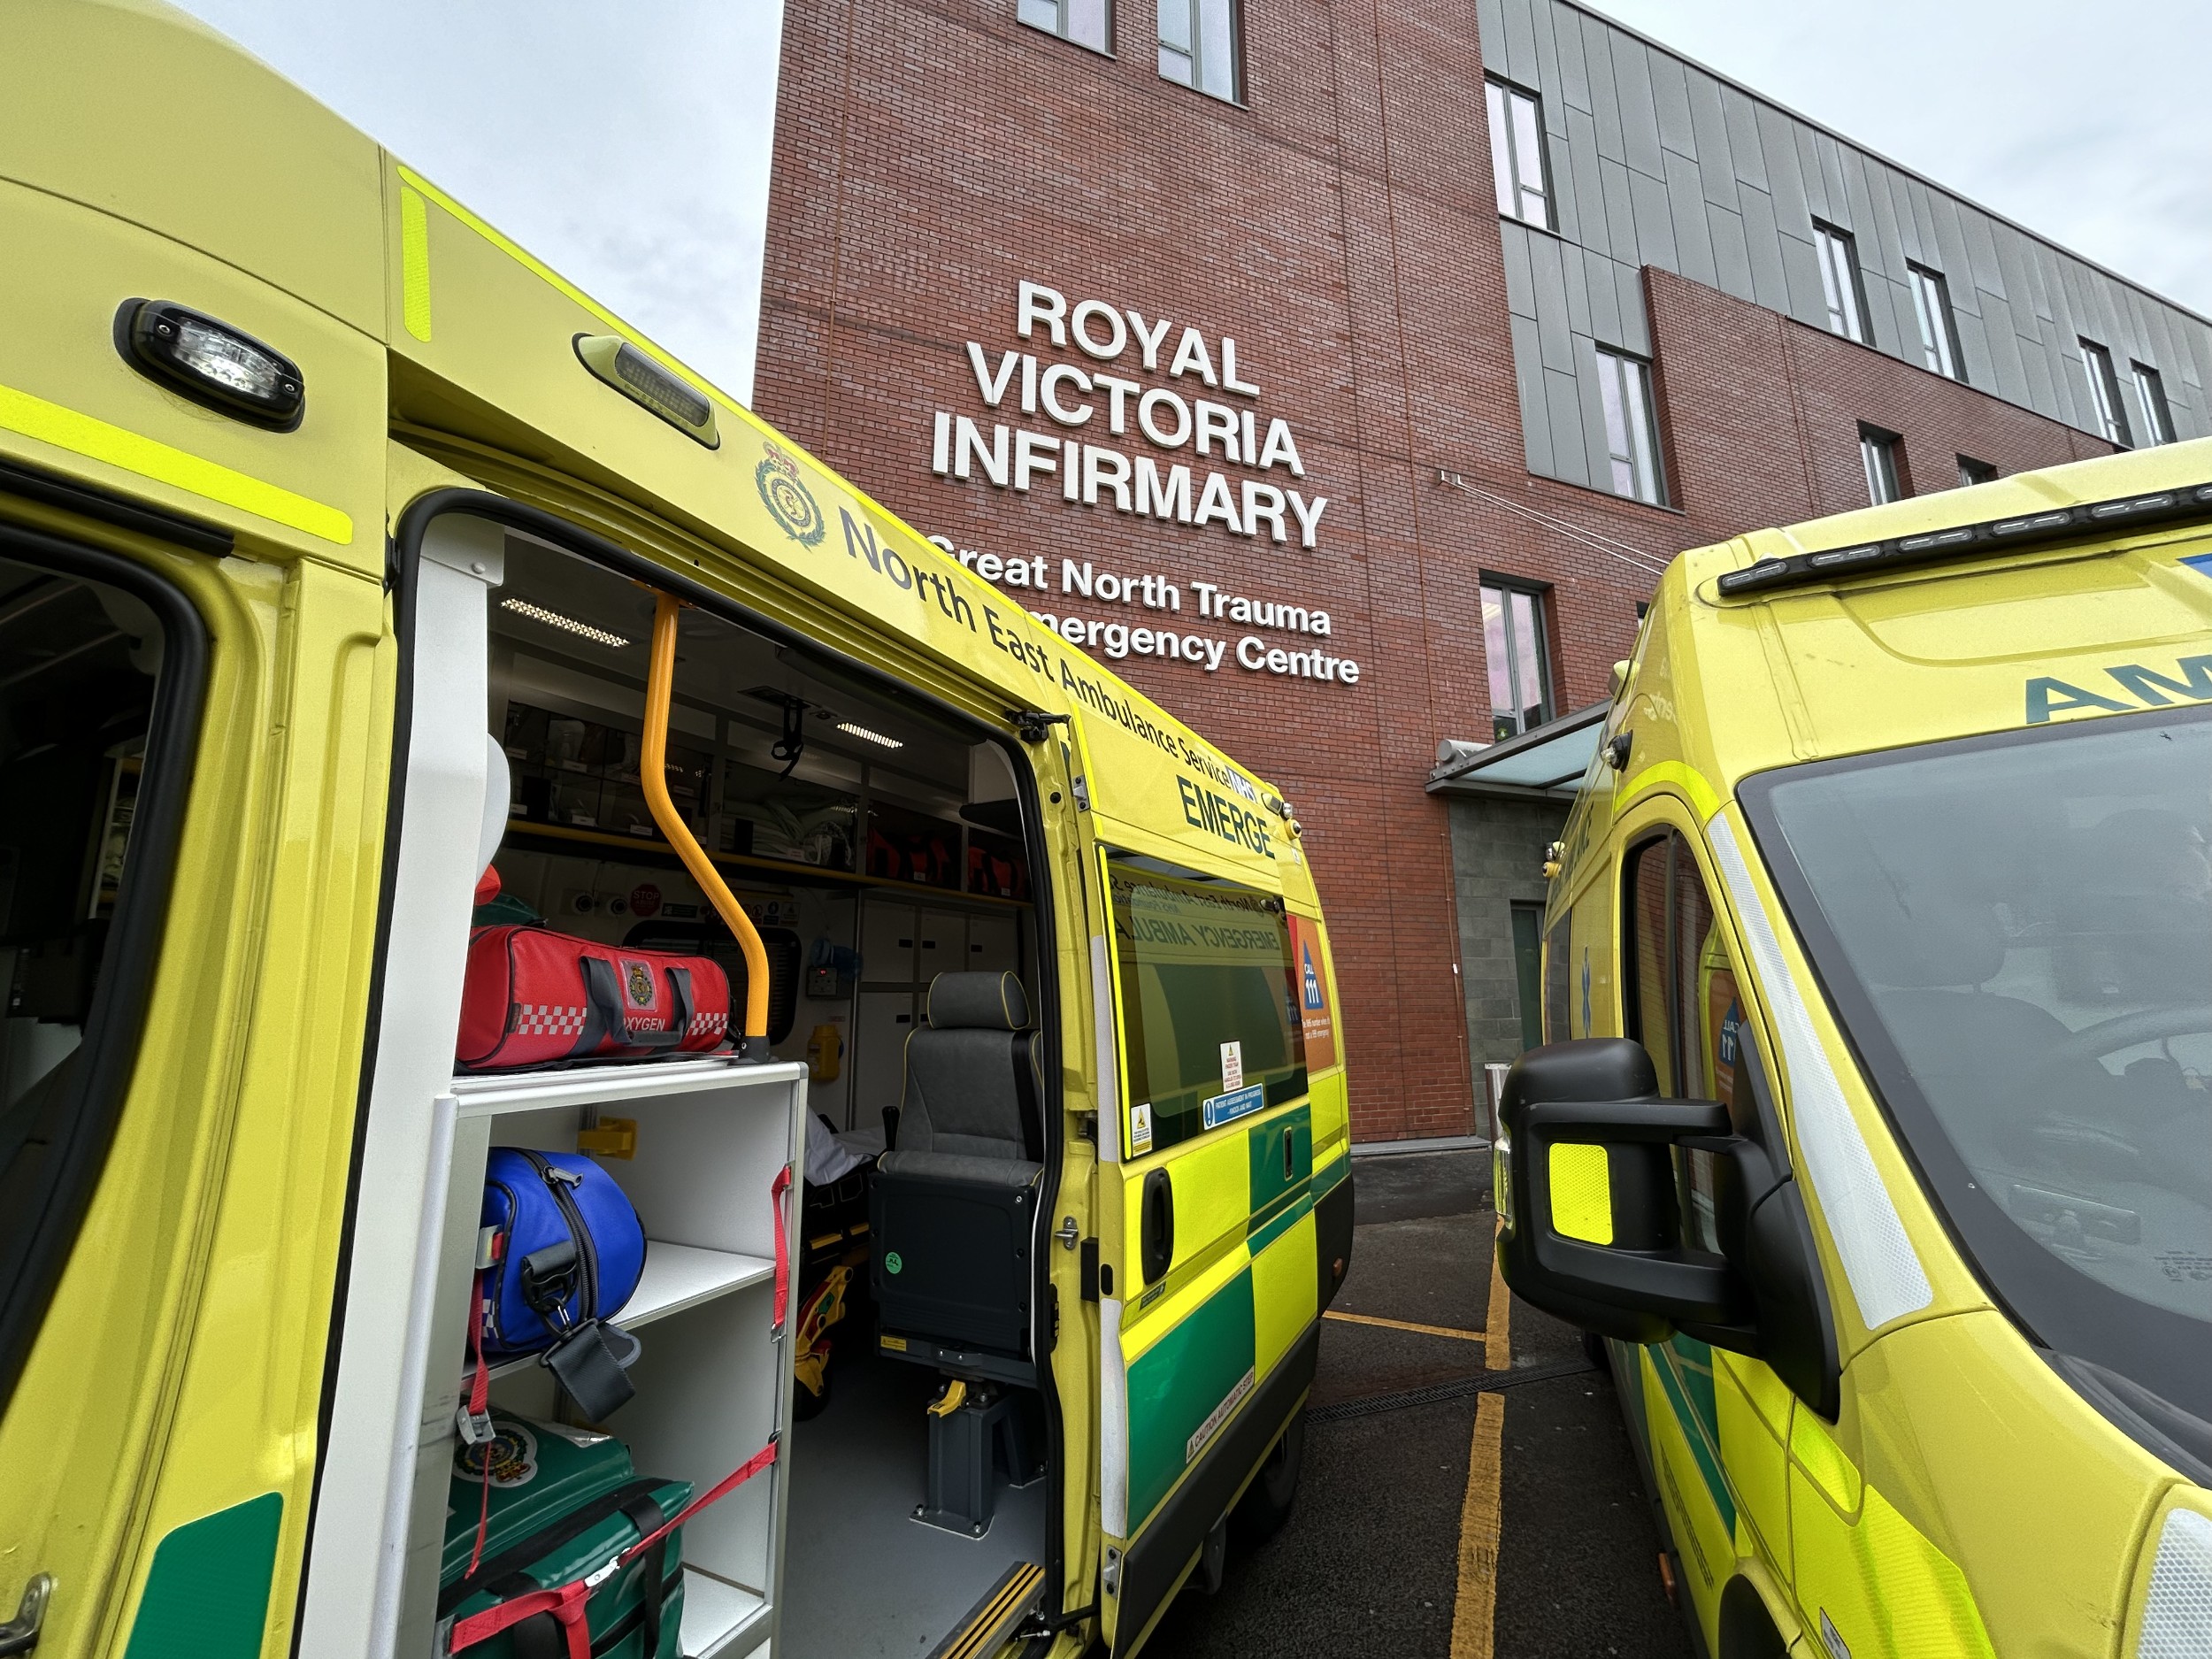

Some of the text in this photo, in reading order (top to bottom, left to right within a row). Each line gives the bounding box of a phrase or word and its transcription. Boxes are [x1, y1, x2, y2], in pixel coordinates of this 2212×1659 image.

[1018, 279, 1260, 398] ROYAL
[966, 341, 1305, 477] VICTORIA
[932, 411, 1327, 549] INFIRMARY
[1062, 557, 1181, 612] North
[1190, 580, 1332, 636] Trauma
[838, 505, 977, 634] North
[982, 603, 1056, 683] East
[1060, 657, 1179, 759] Ambulance
[1178, 736, 1233, 790] Service
[1028, 611, 1360, 685] mergency Centre
[1176, 774, 1275, 860] EMERGE
[633, 890, 660, 900] STOP
[1304, 964, 1314, 975] CALL
[1305, 979, 1319, 1004] 111
[624, 1017, 665, 1032] XYGEN
[1194, 1413, 1218, 1448] CAUTION
[1217, 1384, 1243, 1422] AUTOMATIC
